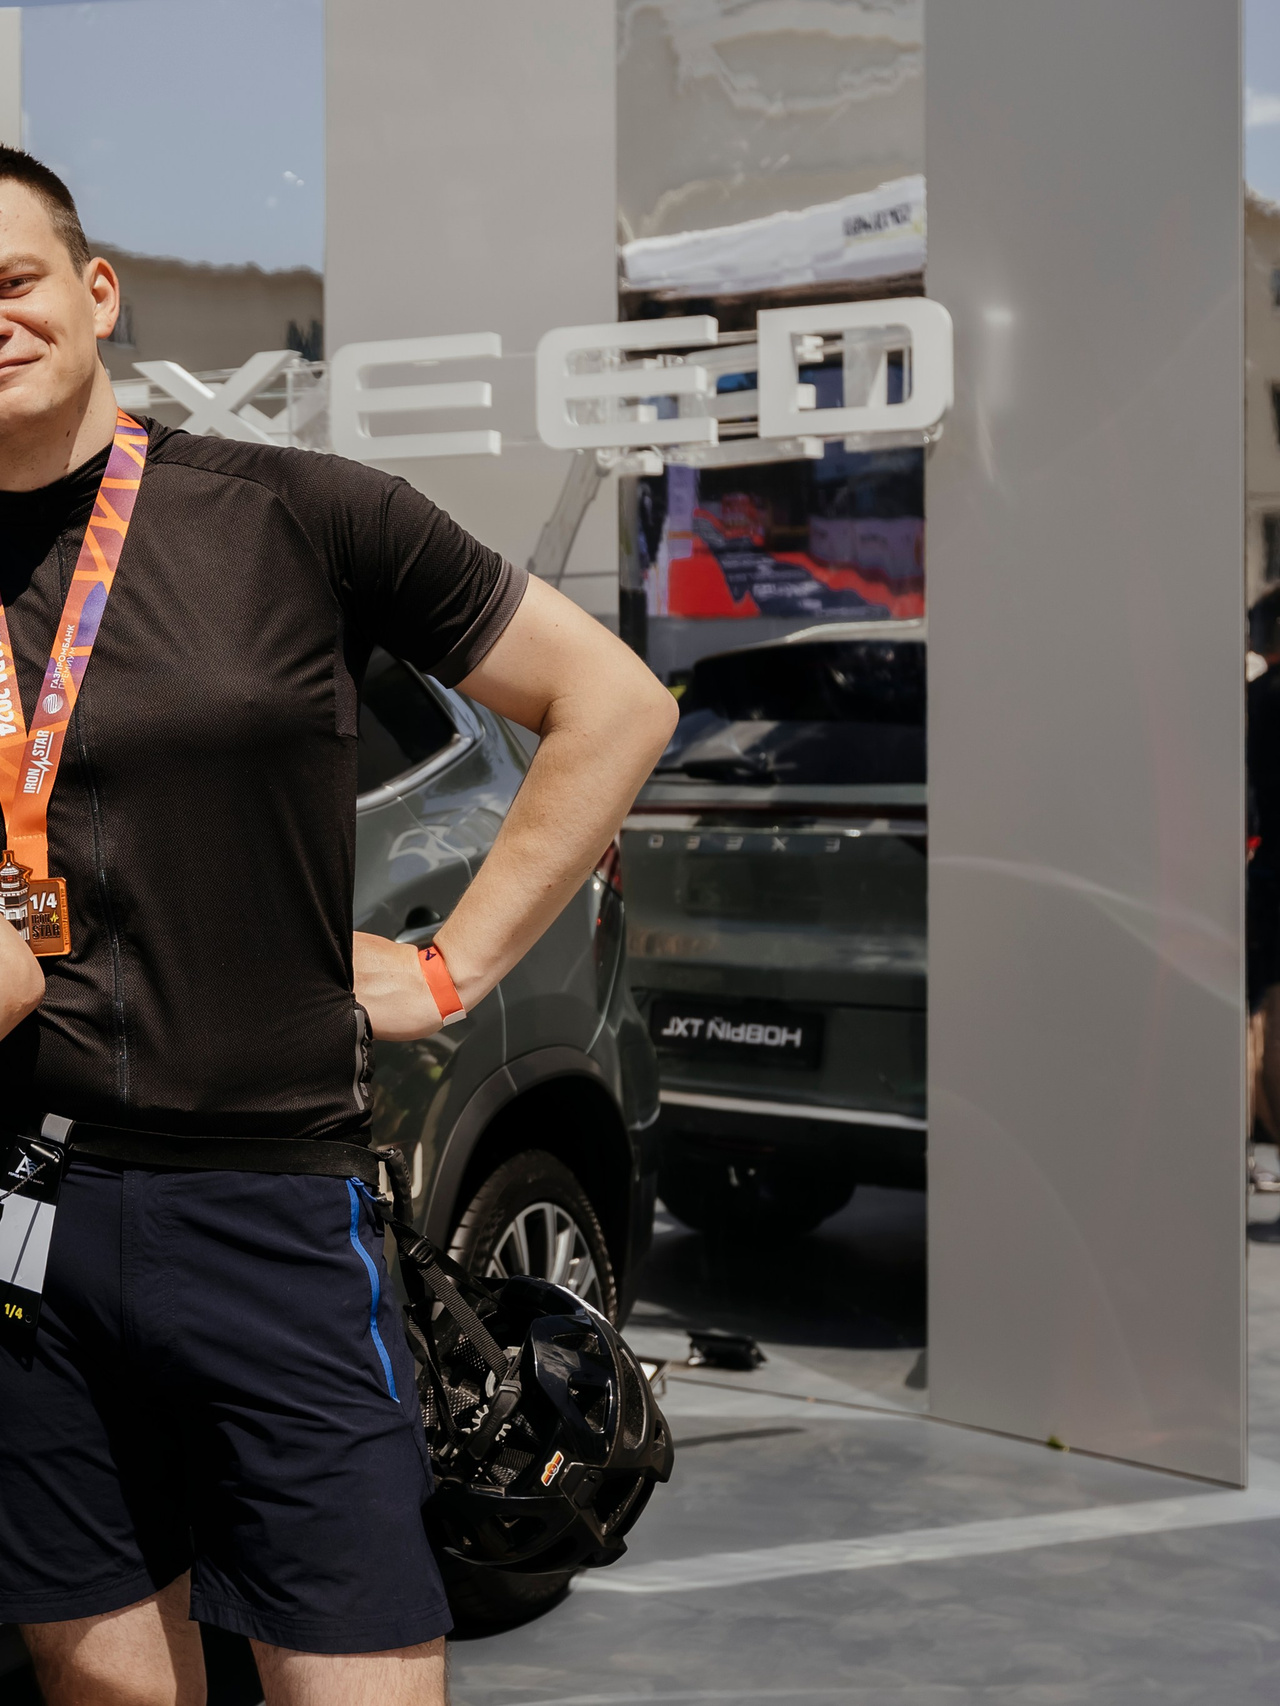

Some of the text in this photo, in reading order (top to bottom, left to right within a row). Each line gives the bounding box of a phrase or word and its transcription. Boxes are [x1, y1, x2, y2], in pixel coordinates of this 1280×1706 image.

[132, 296, 955, 460] XEED
[50, 624, 75, 689] ГАЗПРОМБАНК
[23, 729, 51, 794] IRON STAR
[29, 892, 58, 912] 1/4
[32, 923, 61, 940] STAR
[4, 1303, 23, 1320] 1/4
